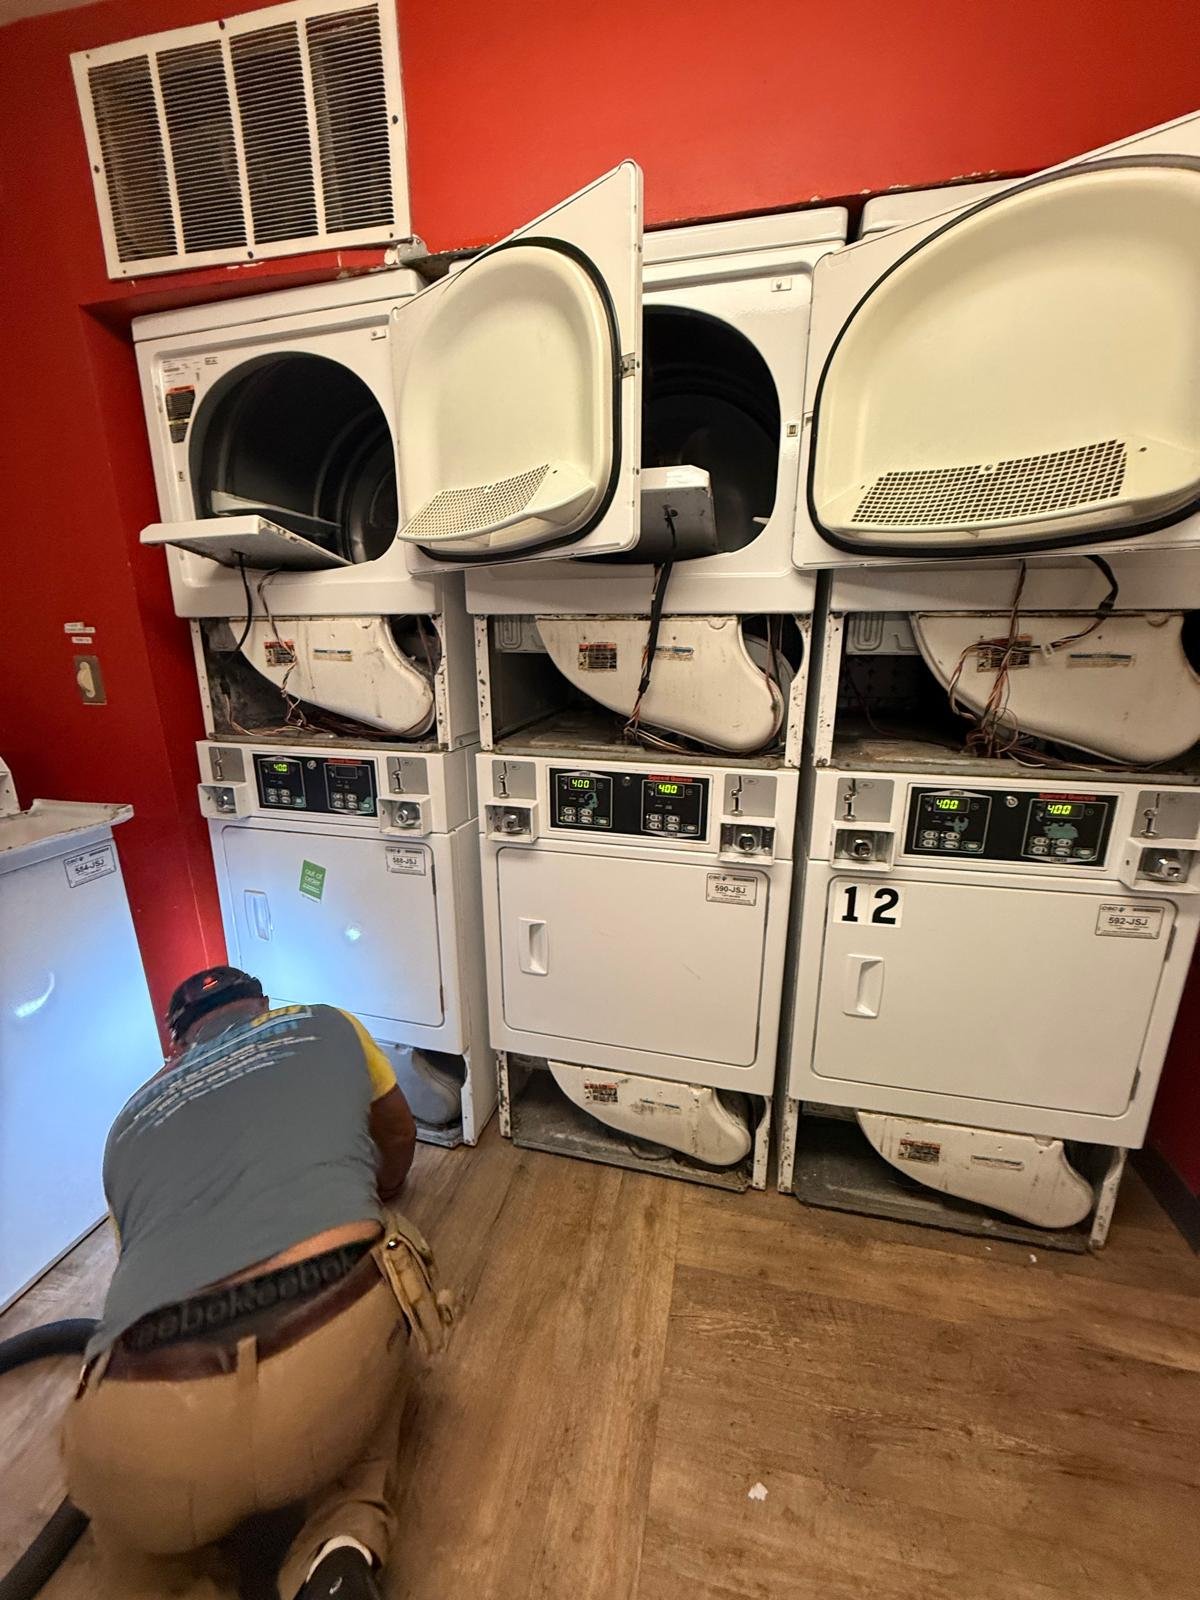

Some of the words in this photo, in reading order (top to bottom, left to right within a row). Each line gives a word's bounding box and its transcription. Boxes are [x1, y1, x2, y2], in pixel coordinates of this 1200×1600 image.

[571, 779, 590, 789] 400
[658, 784, 678, 794] 400
[936, 799, 959, 810] 400
[1047, 804, 1072, 815] 400
[714, 884, 746, 894] 590-JSJ
[841, 886, 900, 925] 12
[1108, 916, 1148, 926] 592-JSJ
